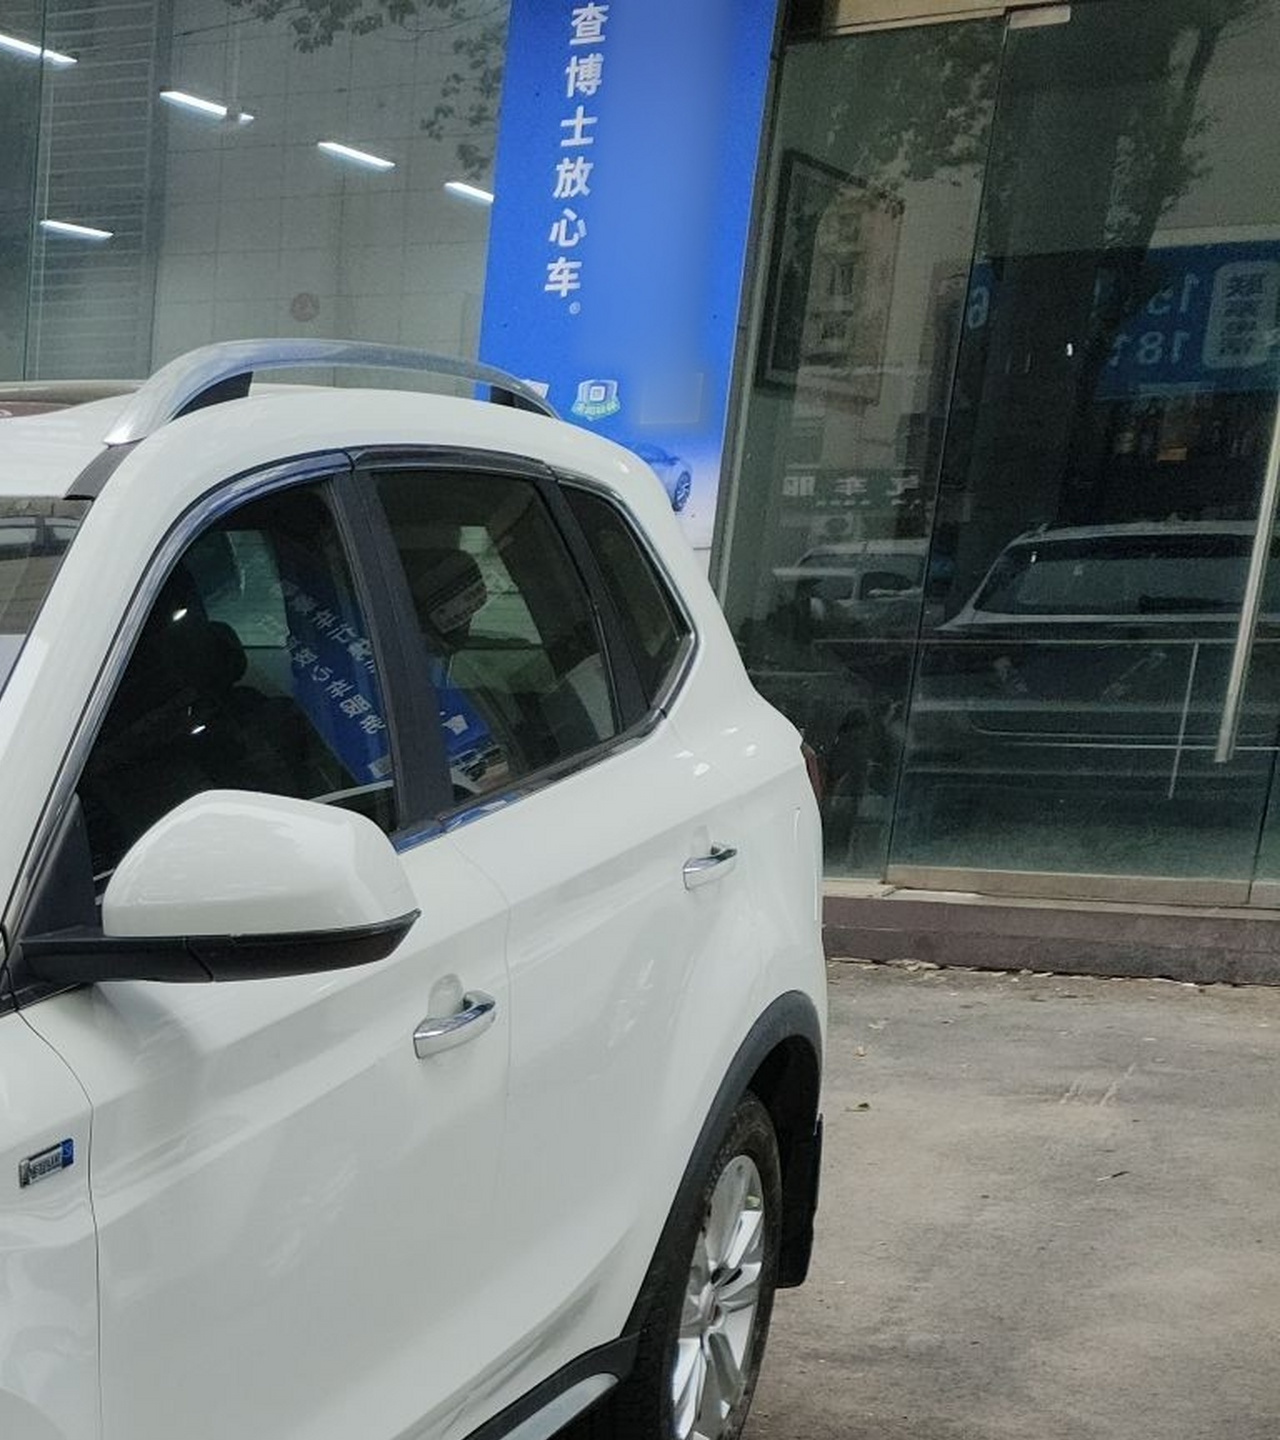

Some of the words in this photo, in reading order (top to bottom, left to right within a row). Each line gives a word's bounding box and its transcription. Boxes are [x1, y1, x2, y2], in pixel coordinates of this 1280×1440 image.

[544, 2, 608, 298] 查博士放心车
